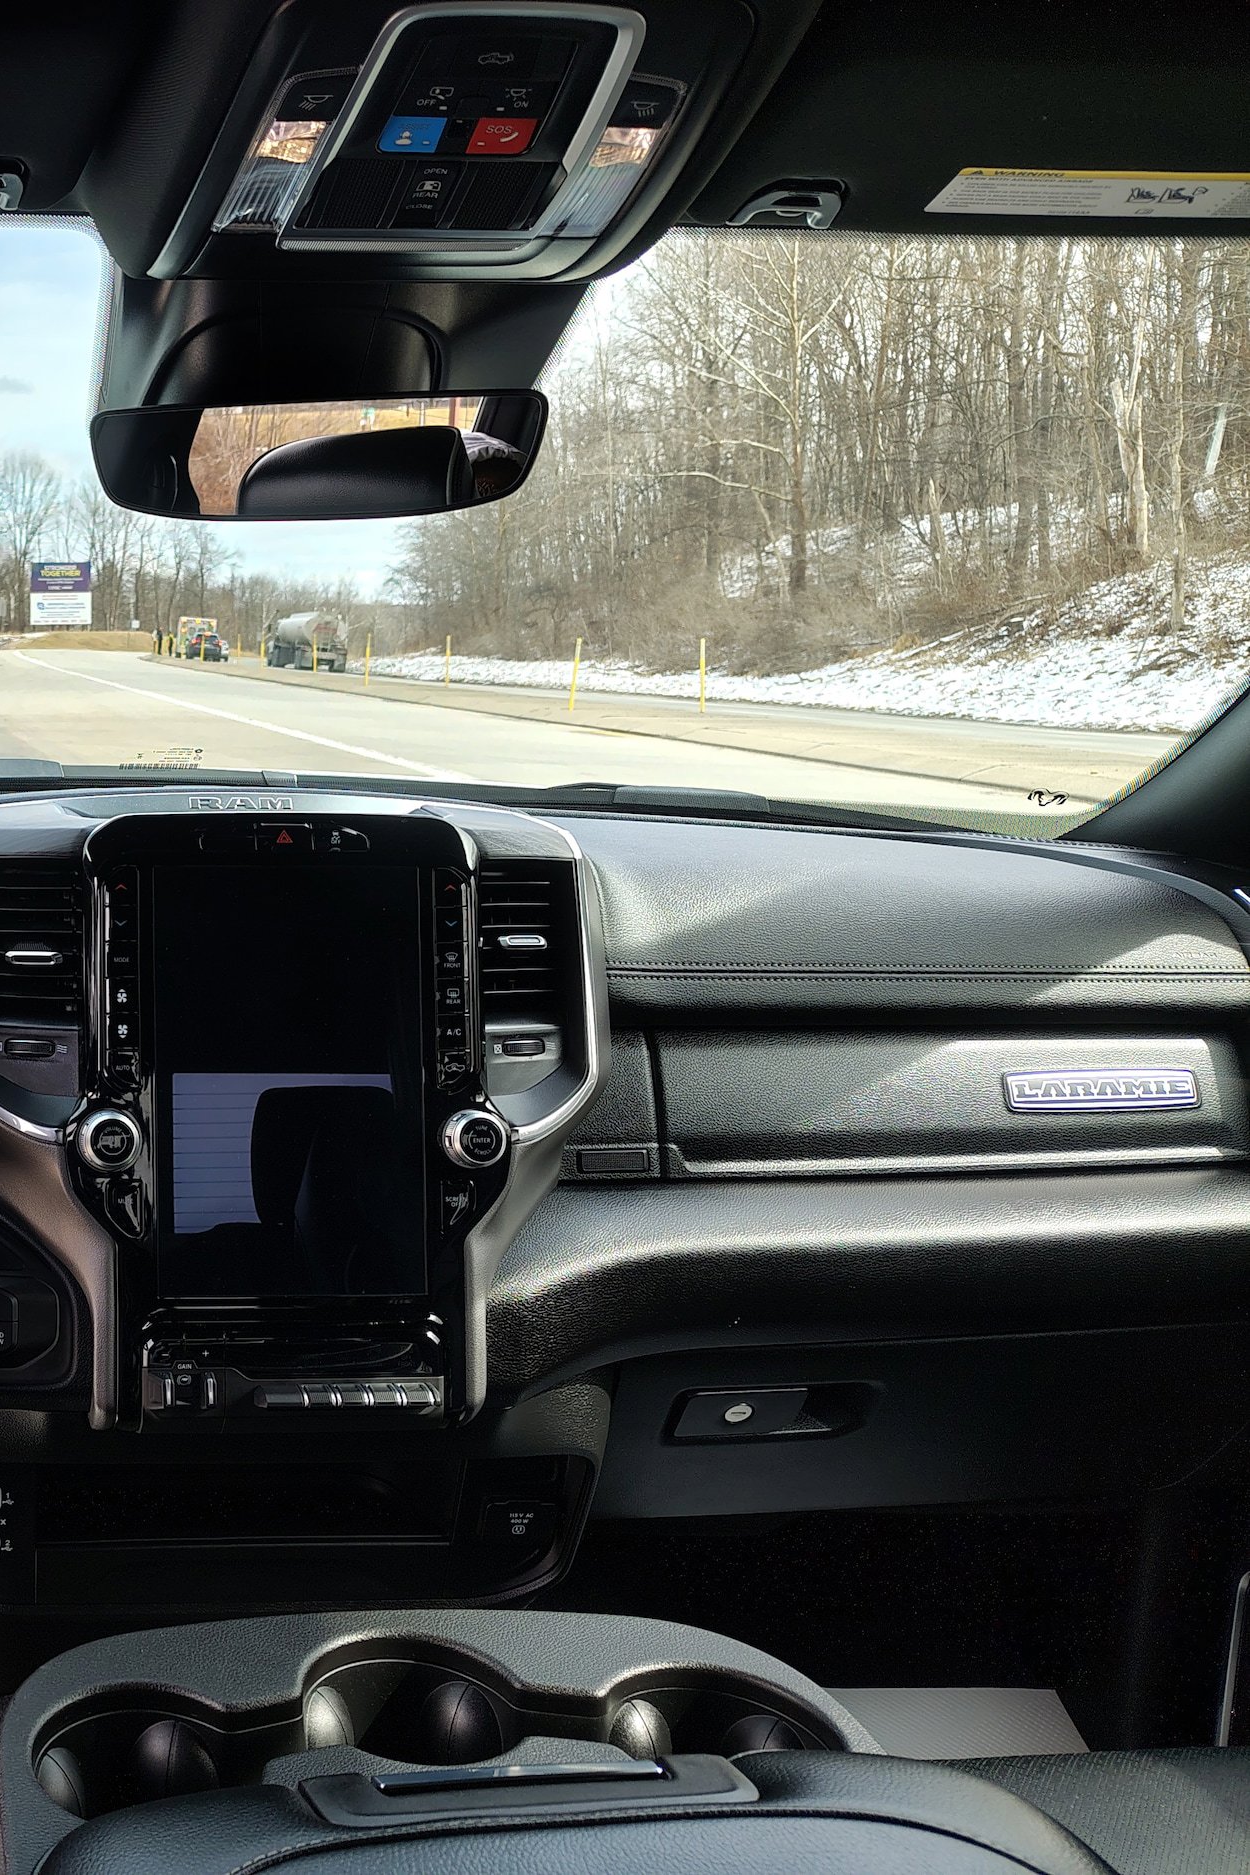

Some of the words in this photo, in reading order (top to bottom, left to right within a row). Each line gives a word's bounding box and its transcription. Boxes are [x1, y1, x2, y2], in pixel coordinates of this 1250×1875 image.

[416, 98, 436, 106] OFF
[513, 100, 529, 108] ON
[485, 125, 512, 134] SOS
[993, 170, 1066, 178] WARNING
[188, 796, 294, 810] RAM
[446, 1028, 462, 1036] A/C
[1014, 1079, 1192, 1099] LARAMIE
